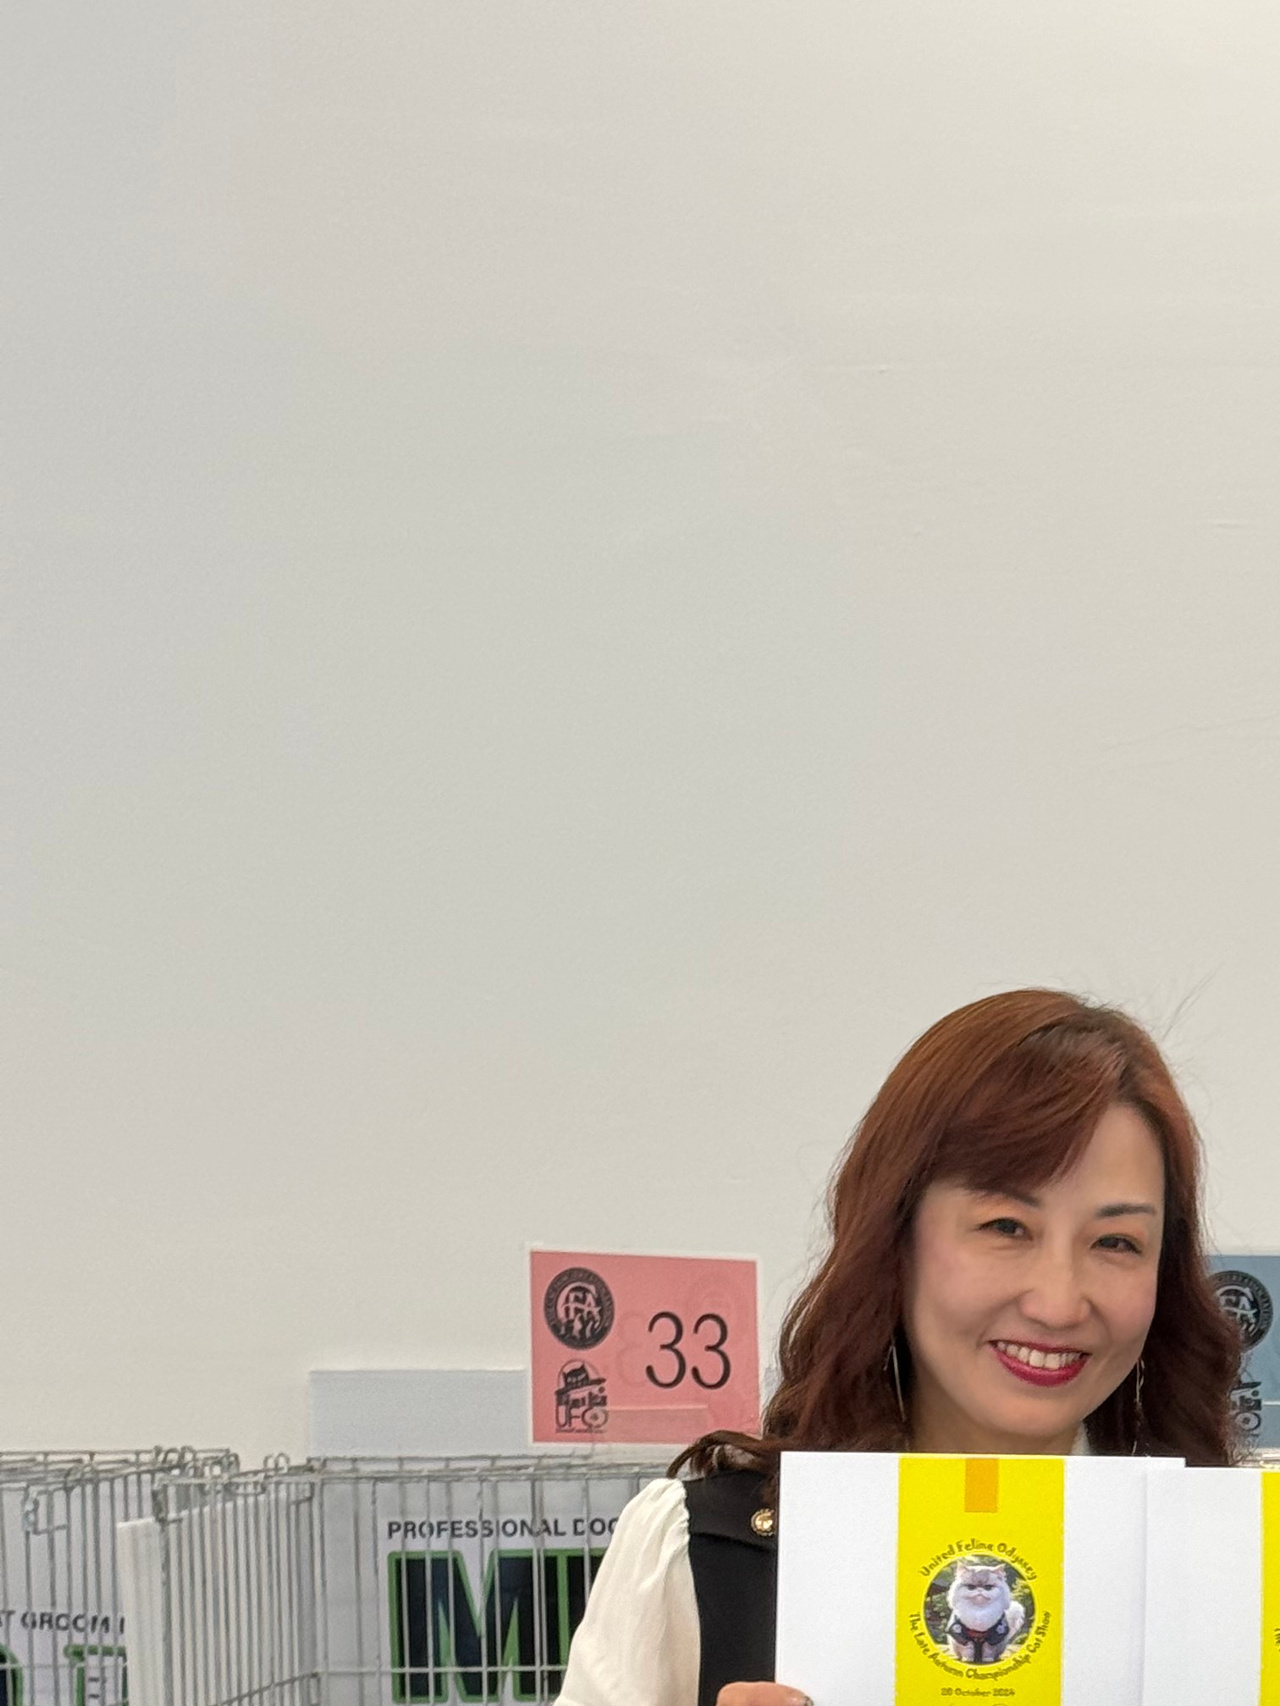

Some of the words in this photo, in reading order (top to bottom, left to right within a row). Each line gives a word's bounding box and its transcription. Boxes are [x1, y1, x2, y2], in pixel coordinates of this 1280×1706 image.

[645, 1310, 731, 1390] 33
[388, 1517, 566, 1539] PROFESSIONAL
[21, 1612, 125, 1634] GROOMI
